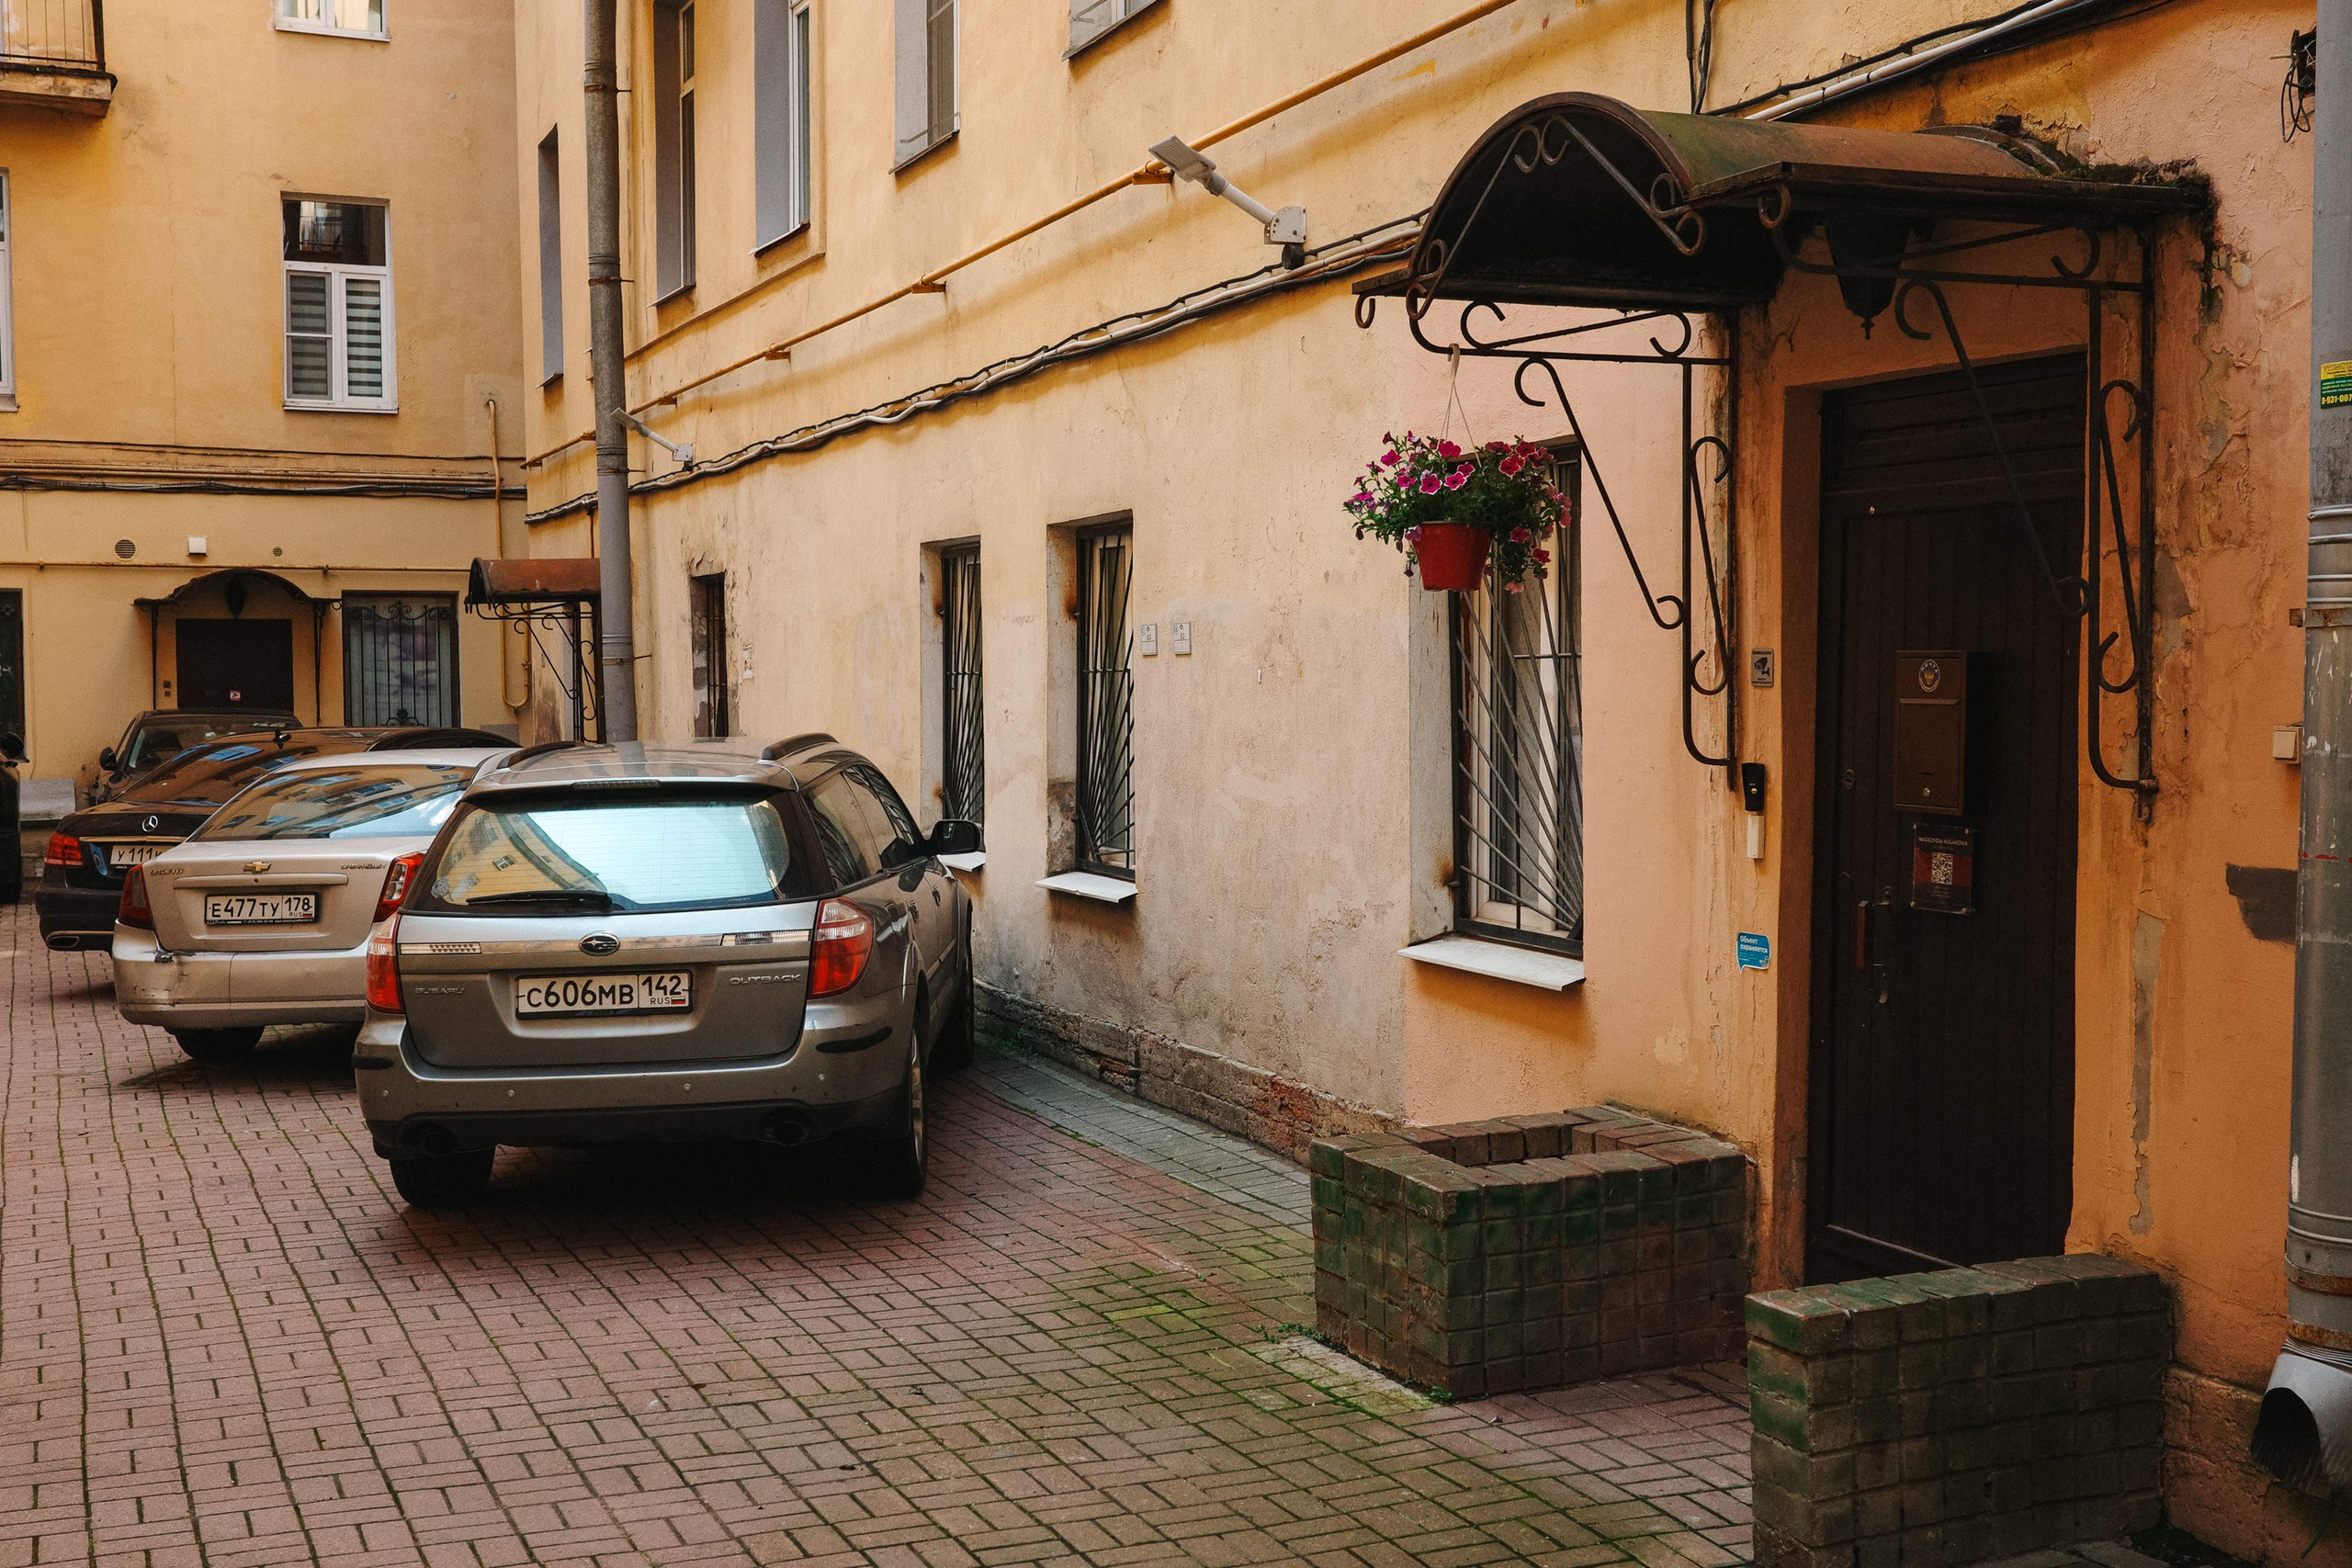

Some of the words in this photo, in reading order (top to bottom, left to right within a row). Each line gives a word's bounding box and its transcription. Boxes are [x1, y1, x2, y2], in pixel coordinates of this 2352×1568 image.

[211, 898, 279, 917] Е477ТУ
[285, 897, 311, 911] 178
[729, 974, 801, 985] OUTBACK
[526, 979, 634, 1008] С606МВ
[641, 975, 682, 997] 142
[650, 997, 671, 1005] RUS
